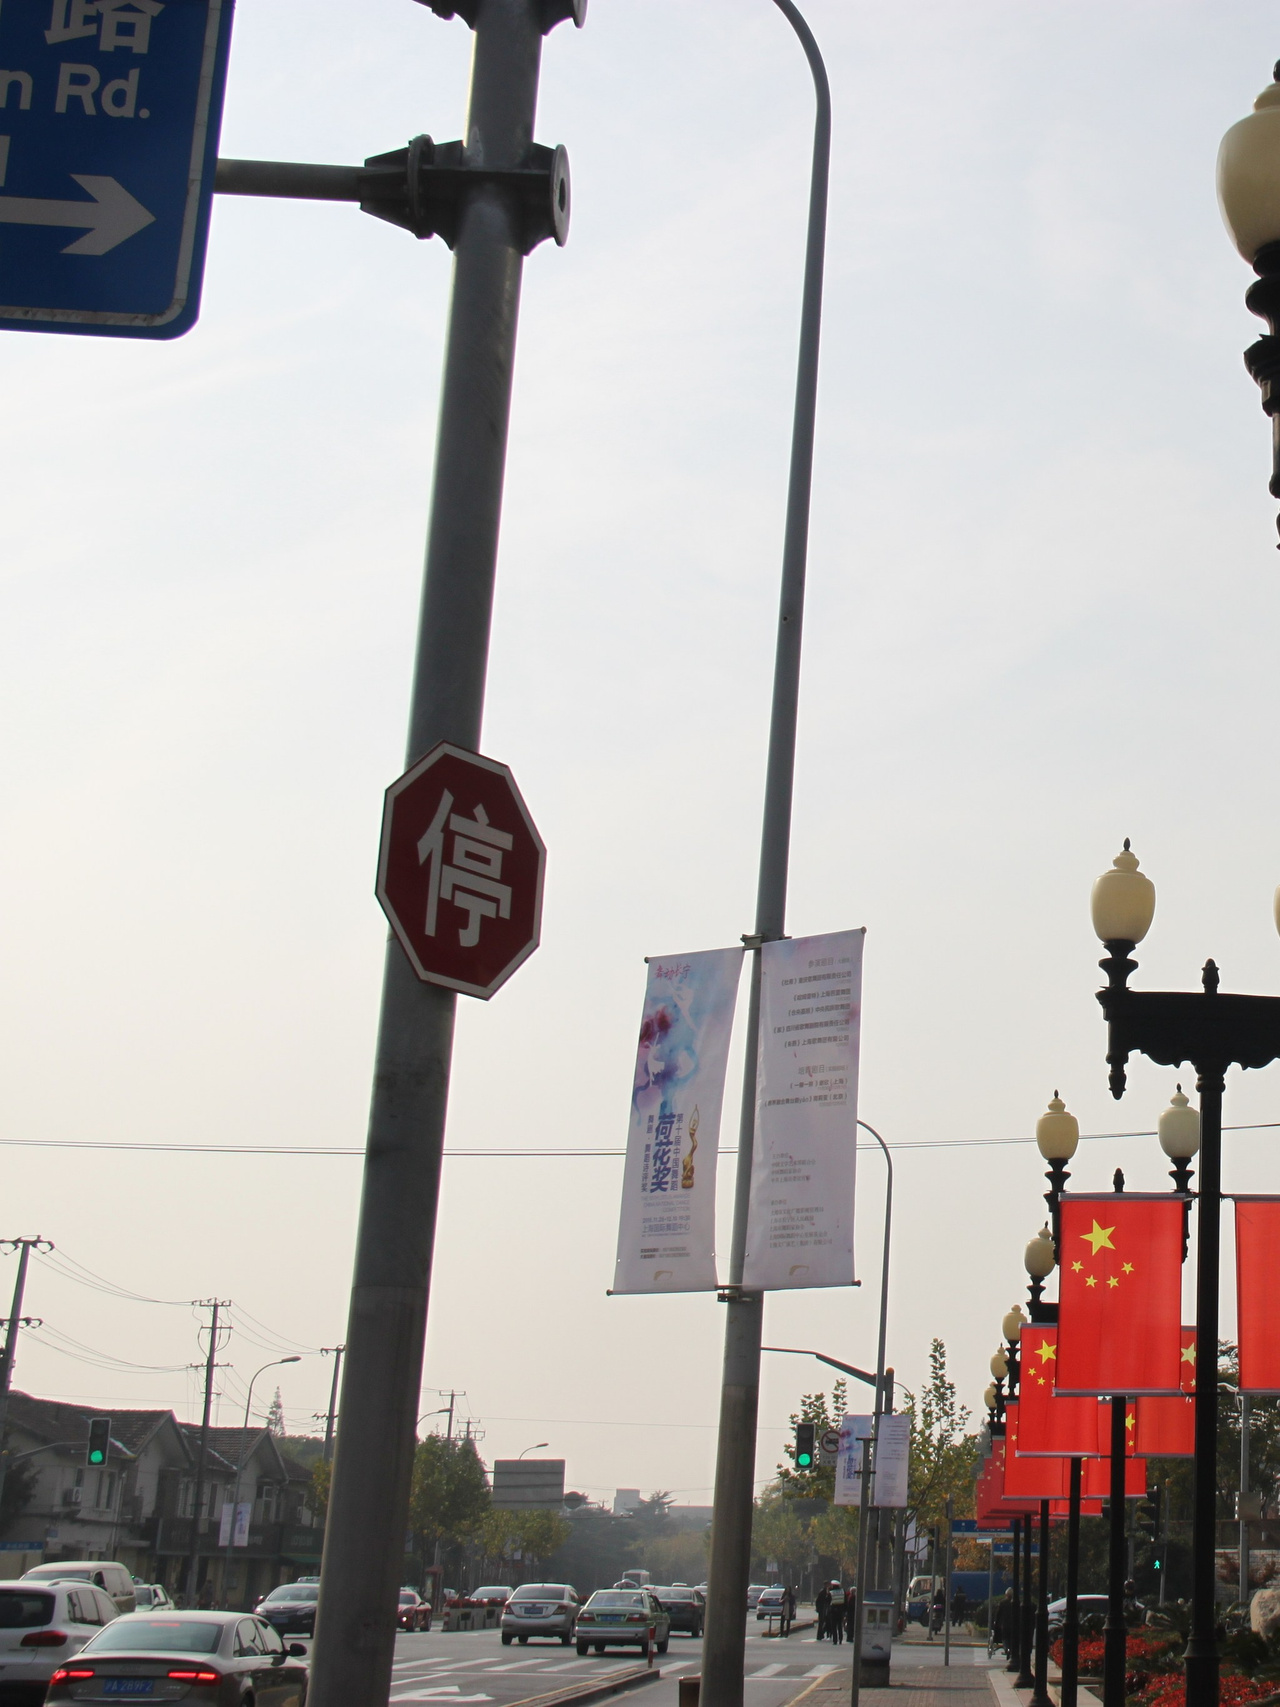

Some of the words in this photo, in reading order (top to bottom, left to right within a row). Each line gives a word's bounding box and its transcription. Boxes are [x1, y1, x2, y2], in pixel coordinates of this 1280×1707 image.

[55, 62, 150, 118] Rd.
[417, 788, 514, 947] 停
[649, 1111, 676, 1193] 荷花奖
